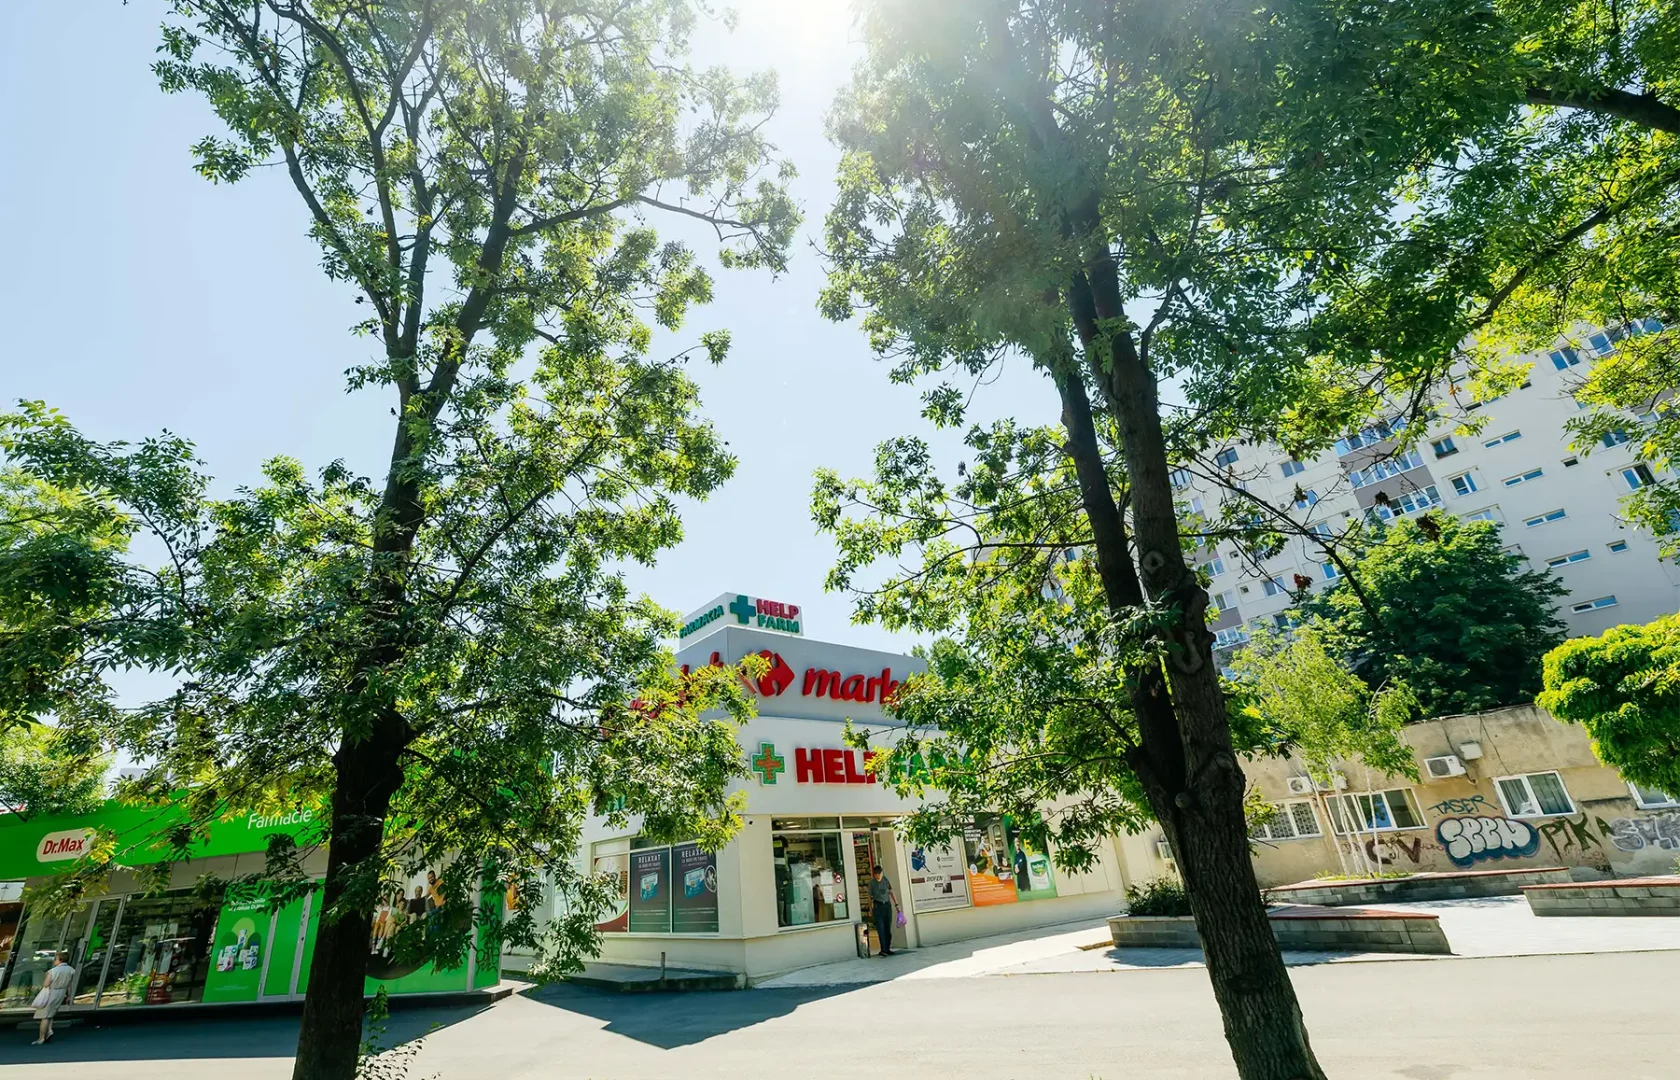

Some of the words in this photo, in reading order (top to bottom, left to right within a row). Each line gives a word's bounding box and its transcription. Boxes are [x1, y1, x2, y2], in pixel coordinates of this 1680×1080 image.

[756, 599, 799, 620] HELP
[679, 605, 725, 639] FARMACIA
[757, 614, 800, 633] FARM
[802, 667, 908, 706] mark
[247, 809, 312, 830] Farmacie
[43, 837, 84, 855] Dr.Max
